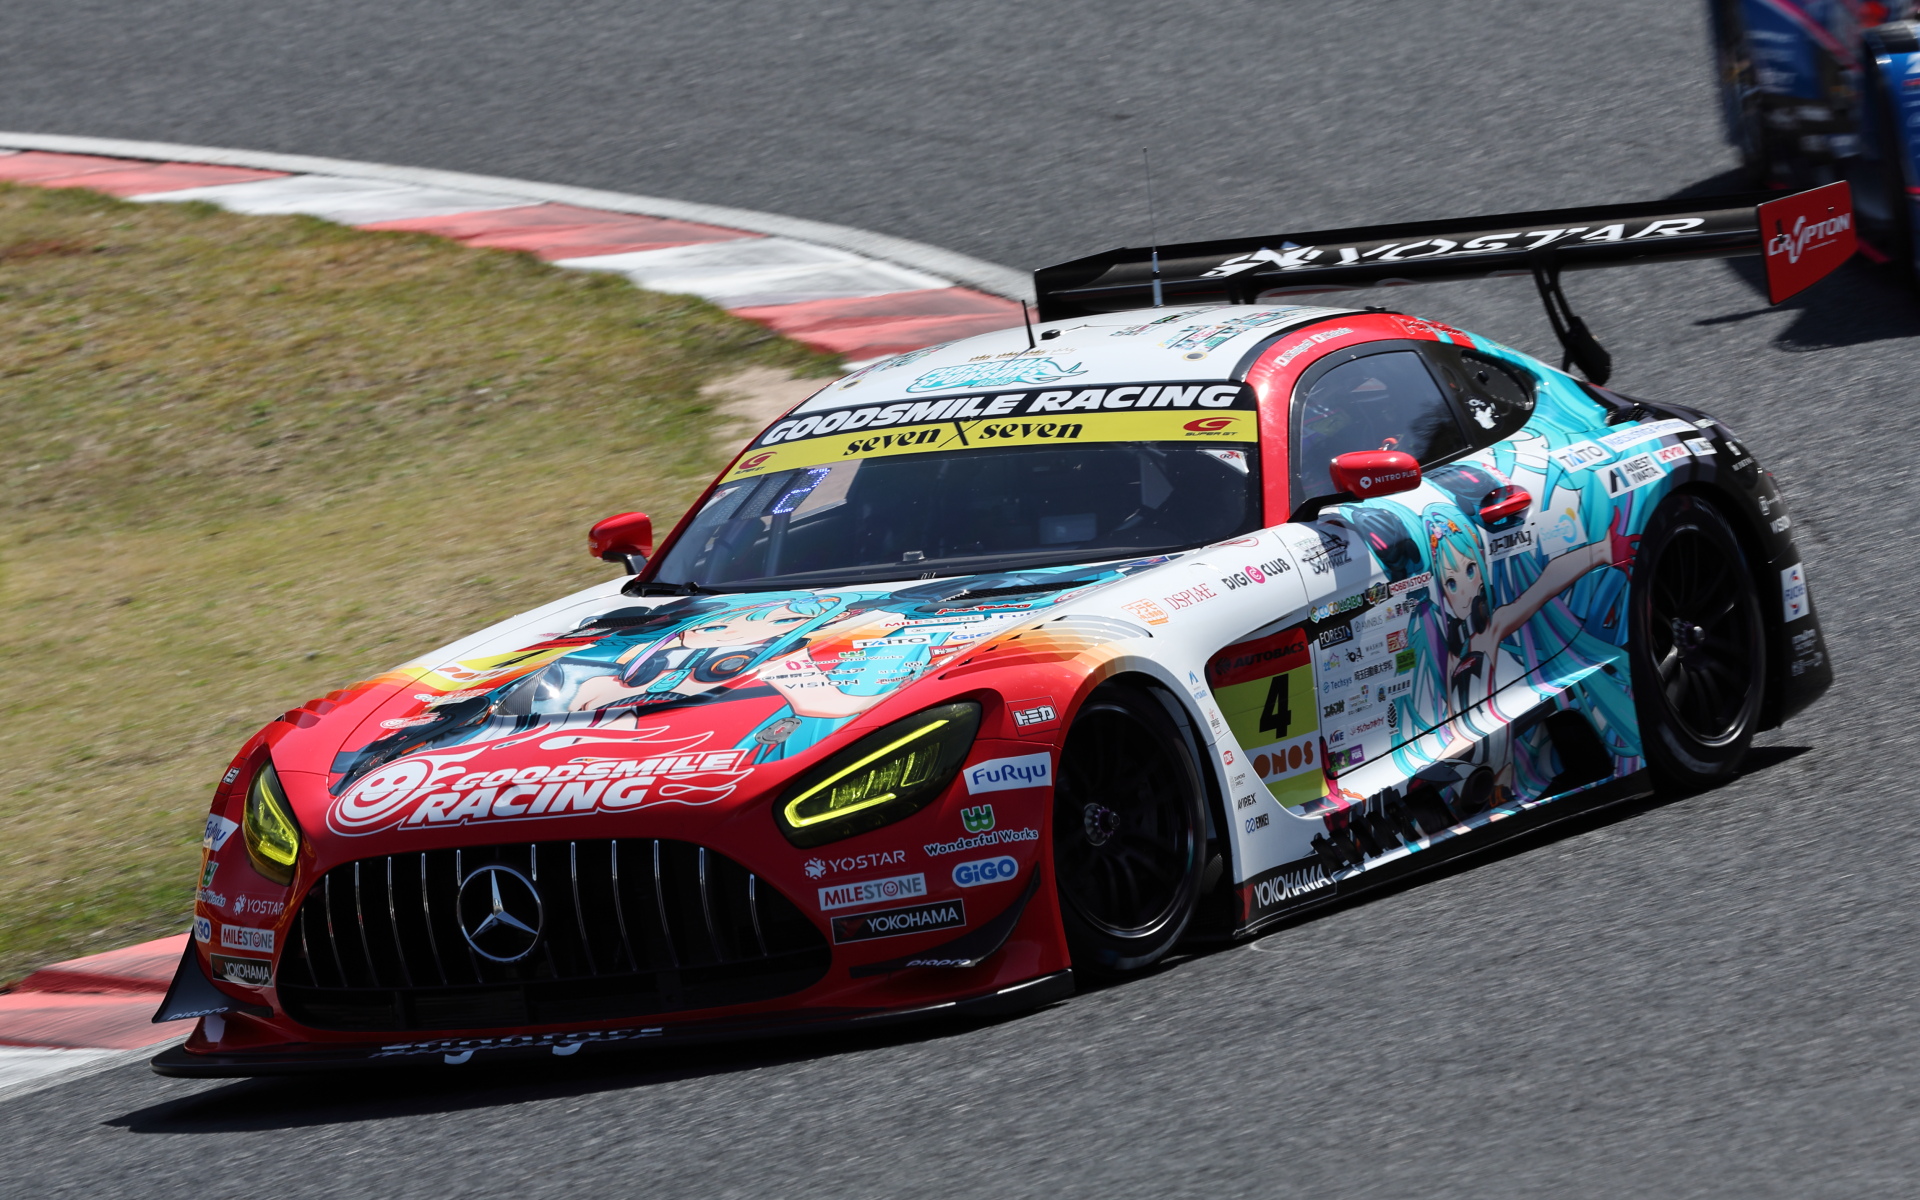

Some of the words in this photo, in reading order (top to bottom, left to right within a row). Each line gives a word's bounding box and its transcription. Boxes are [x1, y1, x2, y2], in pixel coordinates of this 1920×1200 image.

[1768, 213, 1851, 264] CRYPTON
[761, 392, 1023, 446] GOODSMILE
[1026, 385, 1242, 413] RACING
[843, 428, 940, 456] seven
[979, 423, 1083, 442] seven
[1559, 446, 1602, 468] TAITO
[1625, 456, 1650, 474] ANEST
[1375, 472, 1401, 484] NITRO
[1402, 470, 1418, 478] PLUS
[1221, 573, 1252, 591] DIGI
[1262, 558, 1291, 578] CLUB
[1390, 582, 1409, 592] HOBBY
[1410, 573, 1430, 587] STOCK
[1164, 583, 1217, 611] DSPIAE
[884, 615, 981, 628] MILESTONE
[857, 636, 927, 647] TAITO
[1319, 626, 1346, 645] FOREST
[1234, 641, 1305, 668] AUTOBACS
[784, 679, 859, 691] VISION
[1331, 676, 1353, 690] Techsys
[1259, 673, 1292, 740] 4
[451, 752, 740, 791] GOODSMILE
[972, 764, 1046, 784] FuRyu
[406, 776, 656, 823] RACING
[924, 832, 998, 857] Wonderful
[1000, 828, 1039, 842] Works
[829, 850, 906, 873] YOSTAR
[955, 858, 1016, 885] GiGO
[824, 877, 922, 906] MILESTONE
[1254, 864, 1331, 908] YOKOHAMA
[246, 898, 285, 916] YOSTAR
[867, 907, 958, 932] YOKOHAMA
[222, 927, 274, 949] MILESTONE
[225, 961, 270, 981] YOKOHAMA
[905, 958, 971, 968] piapro
